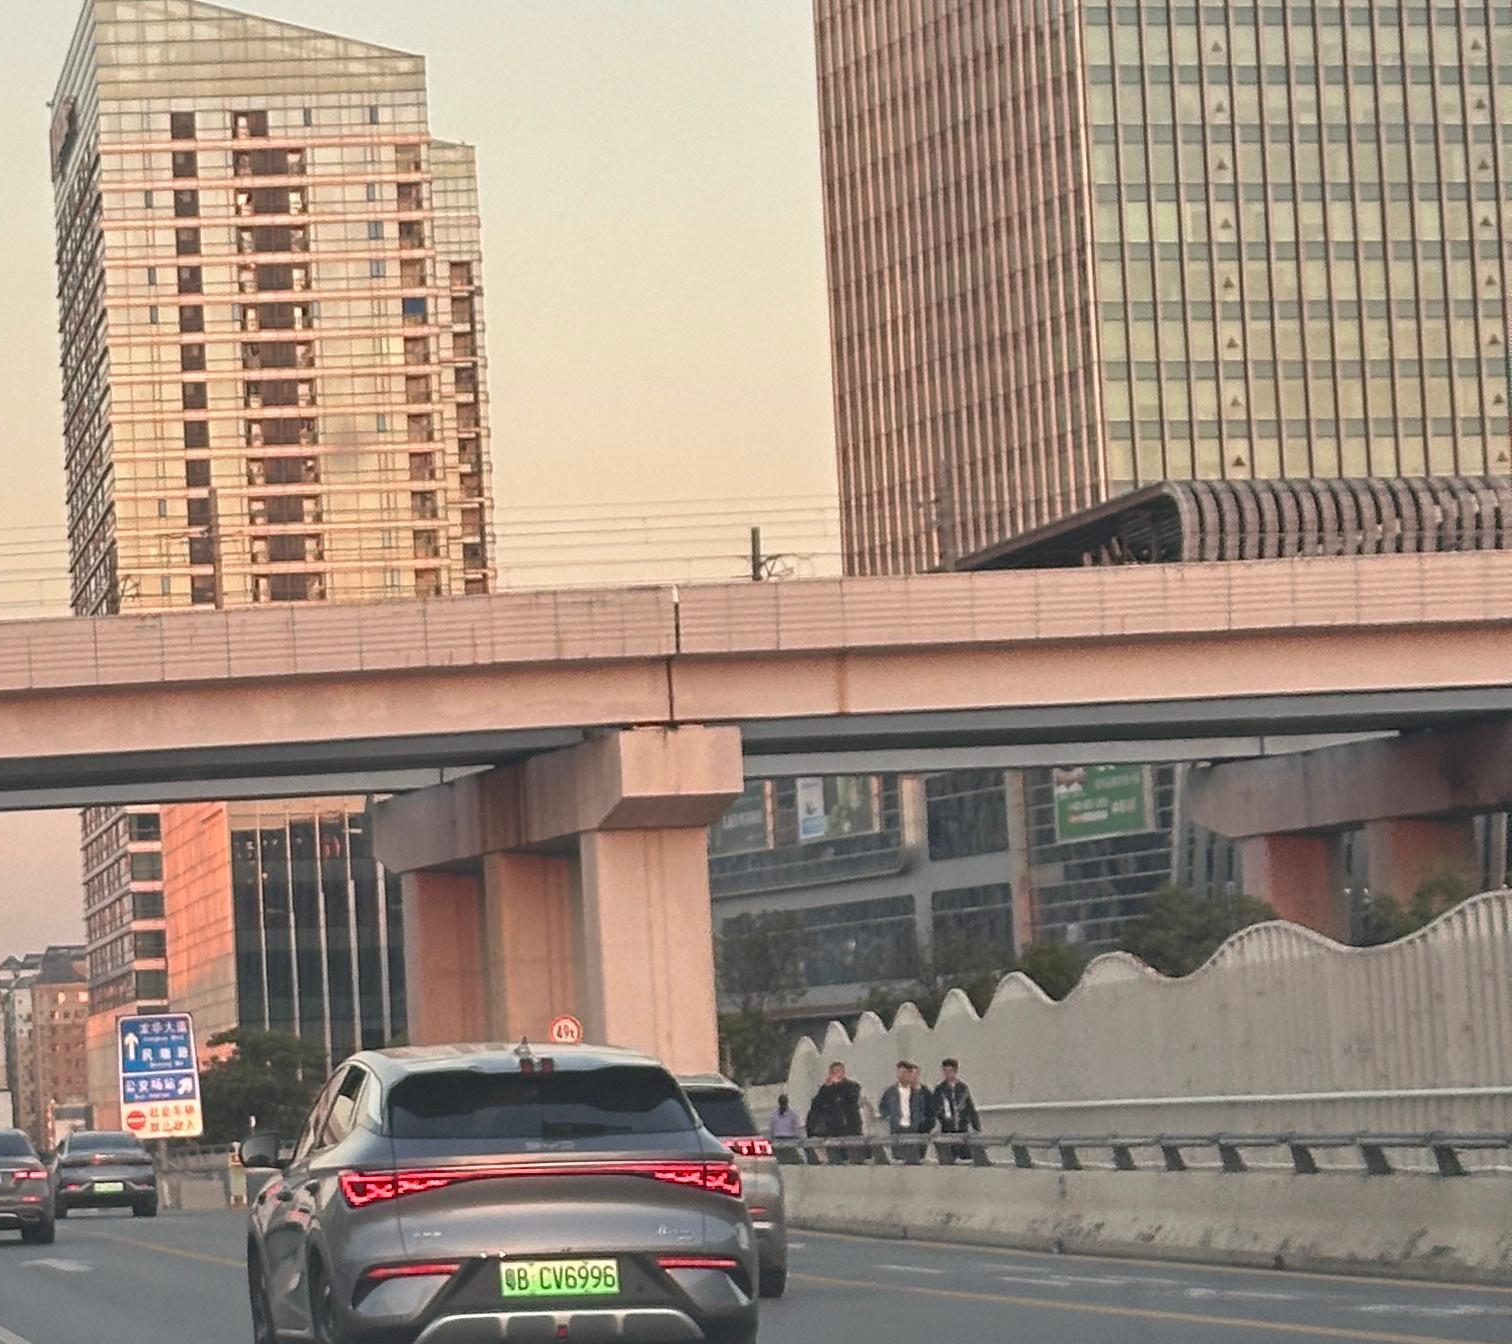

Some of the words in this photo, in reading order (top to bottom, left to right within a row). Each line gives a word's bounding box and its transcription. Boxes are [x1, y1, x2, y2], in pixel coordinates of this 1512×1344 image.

[125, 1077, 176, 1093] 公交场站
[540, 1265, 616, 1290] CV6996
